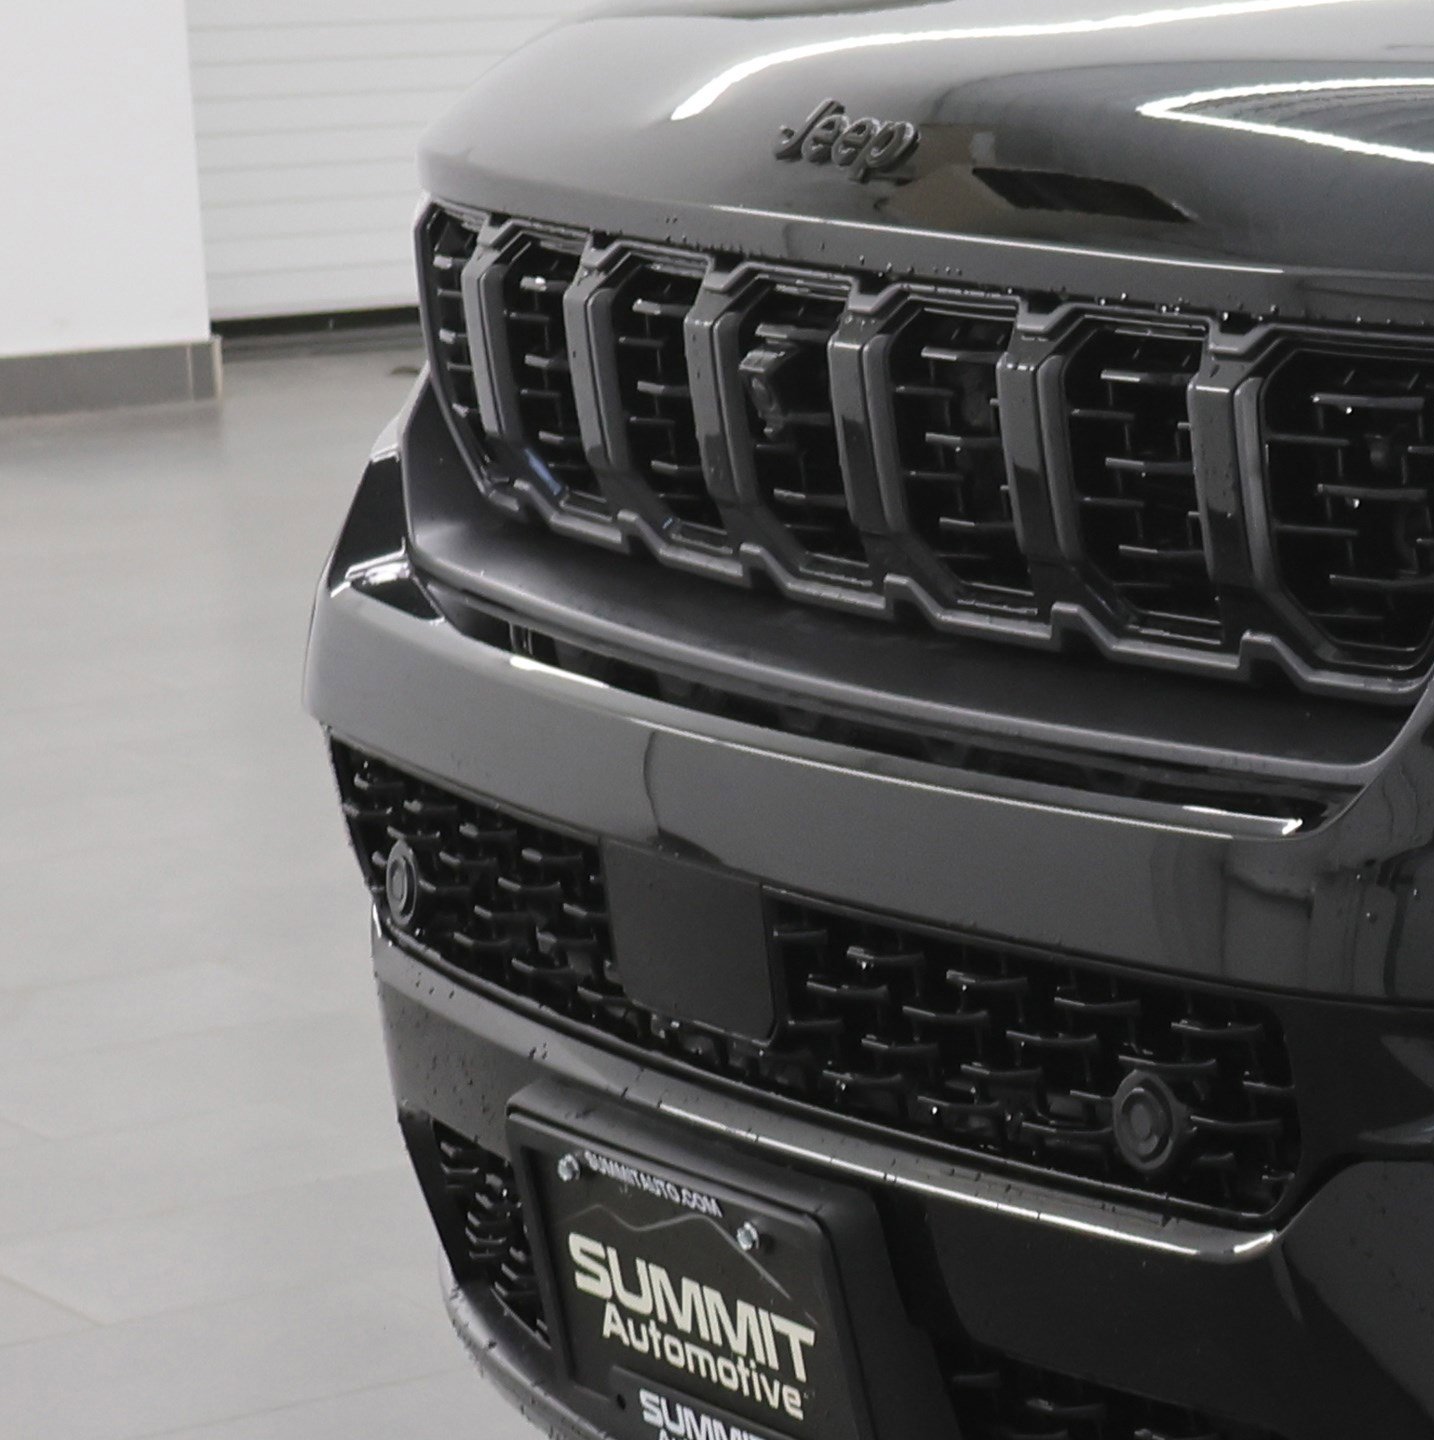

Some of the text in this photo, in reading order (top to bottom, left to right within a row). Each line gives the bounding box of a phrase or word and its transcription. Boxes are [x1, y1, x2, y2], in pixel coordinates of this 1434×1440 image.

[771, 96, 922, 185] Jeep
[567, 1232, 816, 1383] SUMMIT
[602, 1300, 805, 1421] Automotive
